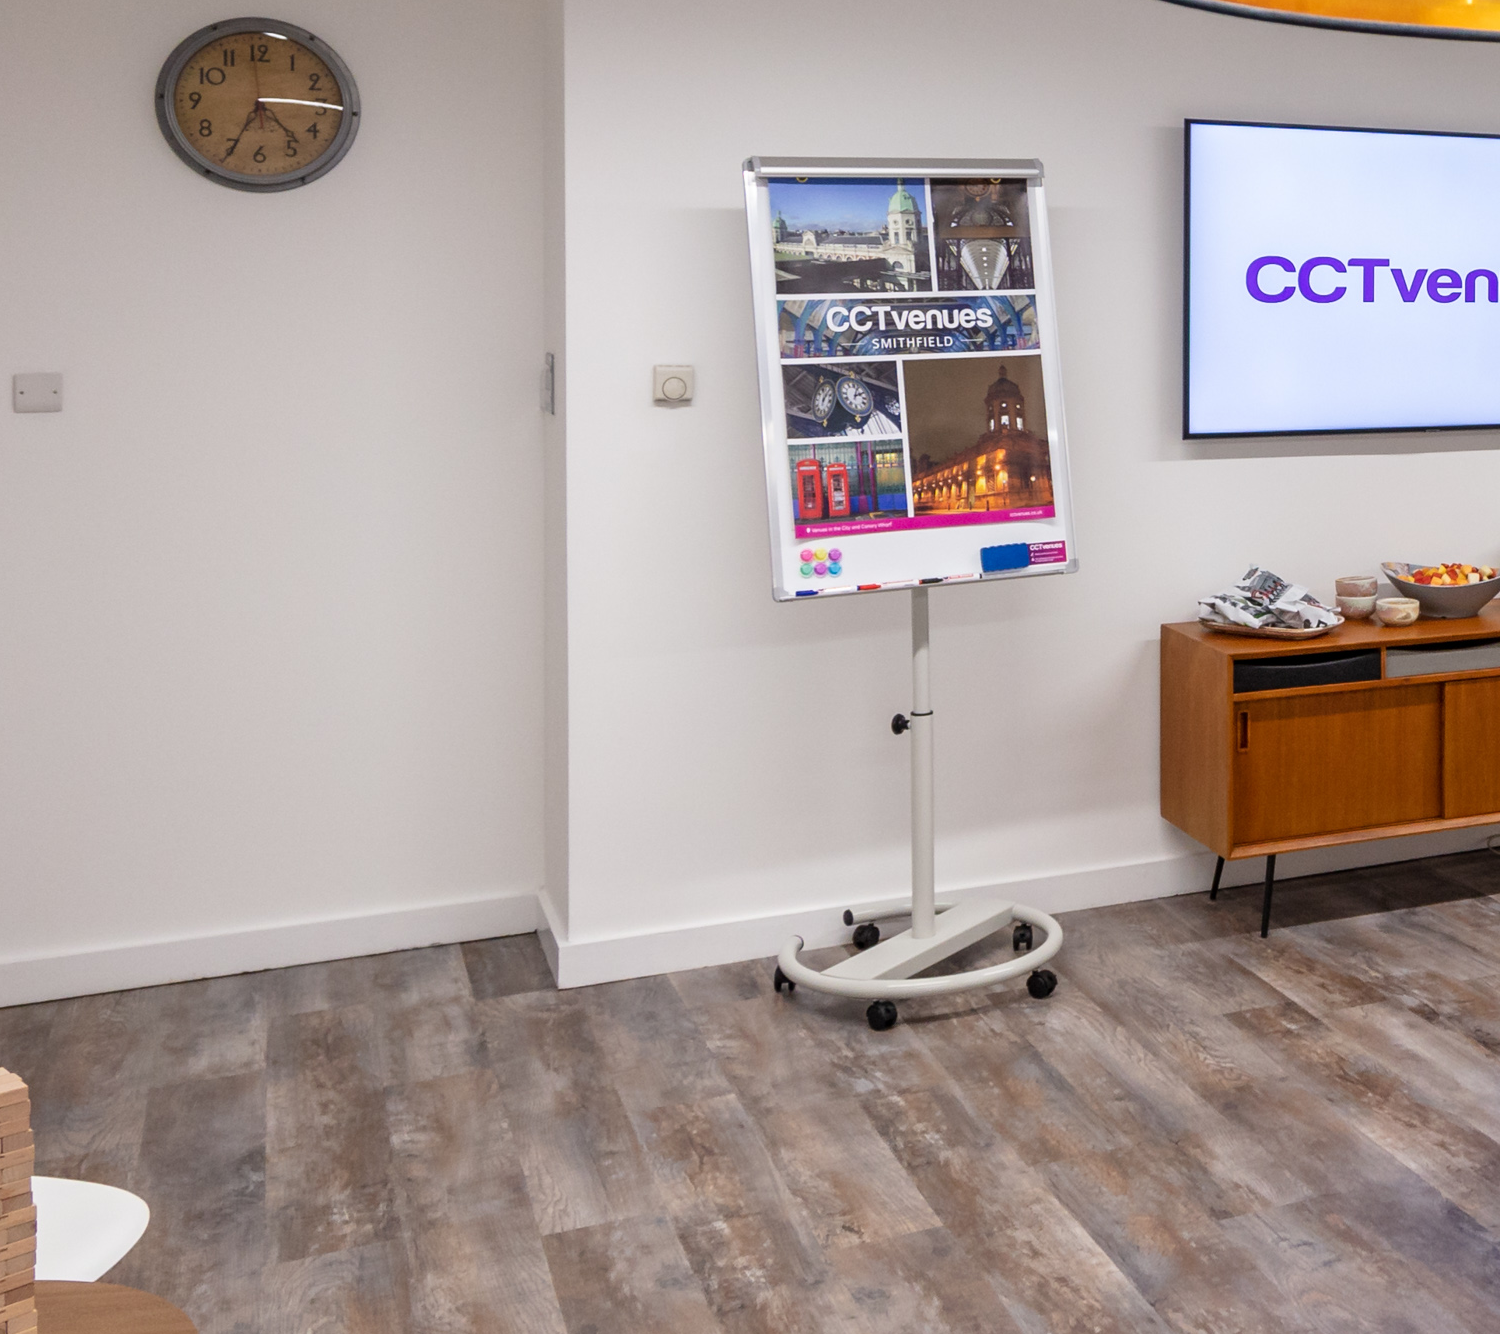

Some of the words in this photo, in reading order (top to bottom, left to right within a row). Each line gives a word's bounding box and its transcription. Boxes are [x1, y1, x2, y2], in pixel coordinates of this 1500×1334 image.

[223, 48, 235, 67] 11
[250, 44, 270, 63] 12
[289, 54, 296, 71] 1
[200, 67, 226, 85] 10
[309, 73, 322, 91] 2
[189, 92, 202, 109] 9
[199, 119, 212, 137] 8
[306, 122, 319, 139] 4
[253, 145, 267, 163] 6
[285, 139, 297, 157] 5
[826, 305, 994, 333] CCTvenues
[871, 335, 954, 350] SMITHFIELD
